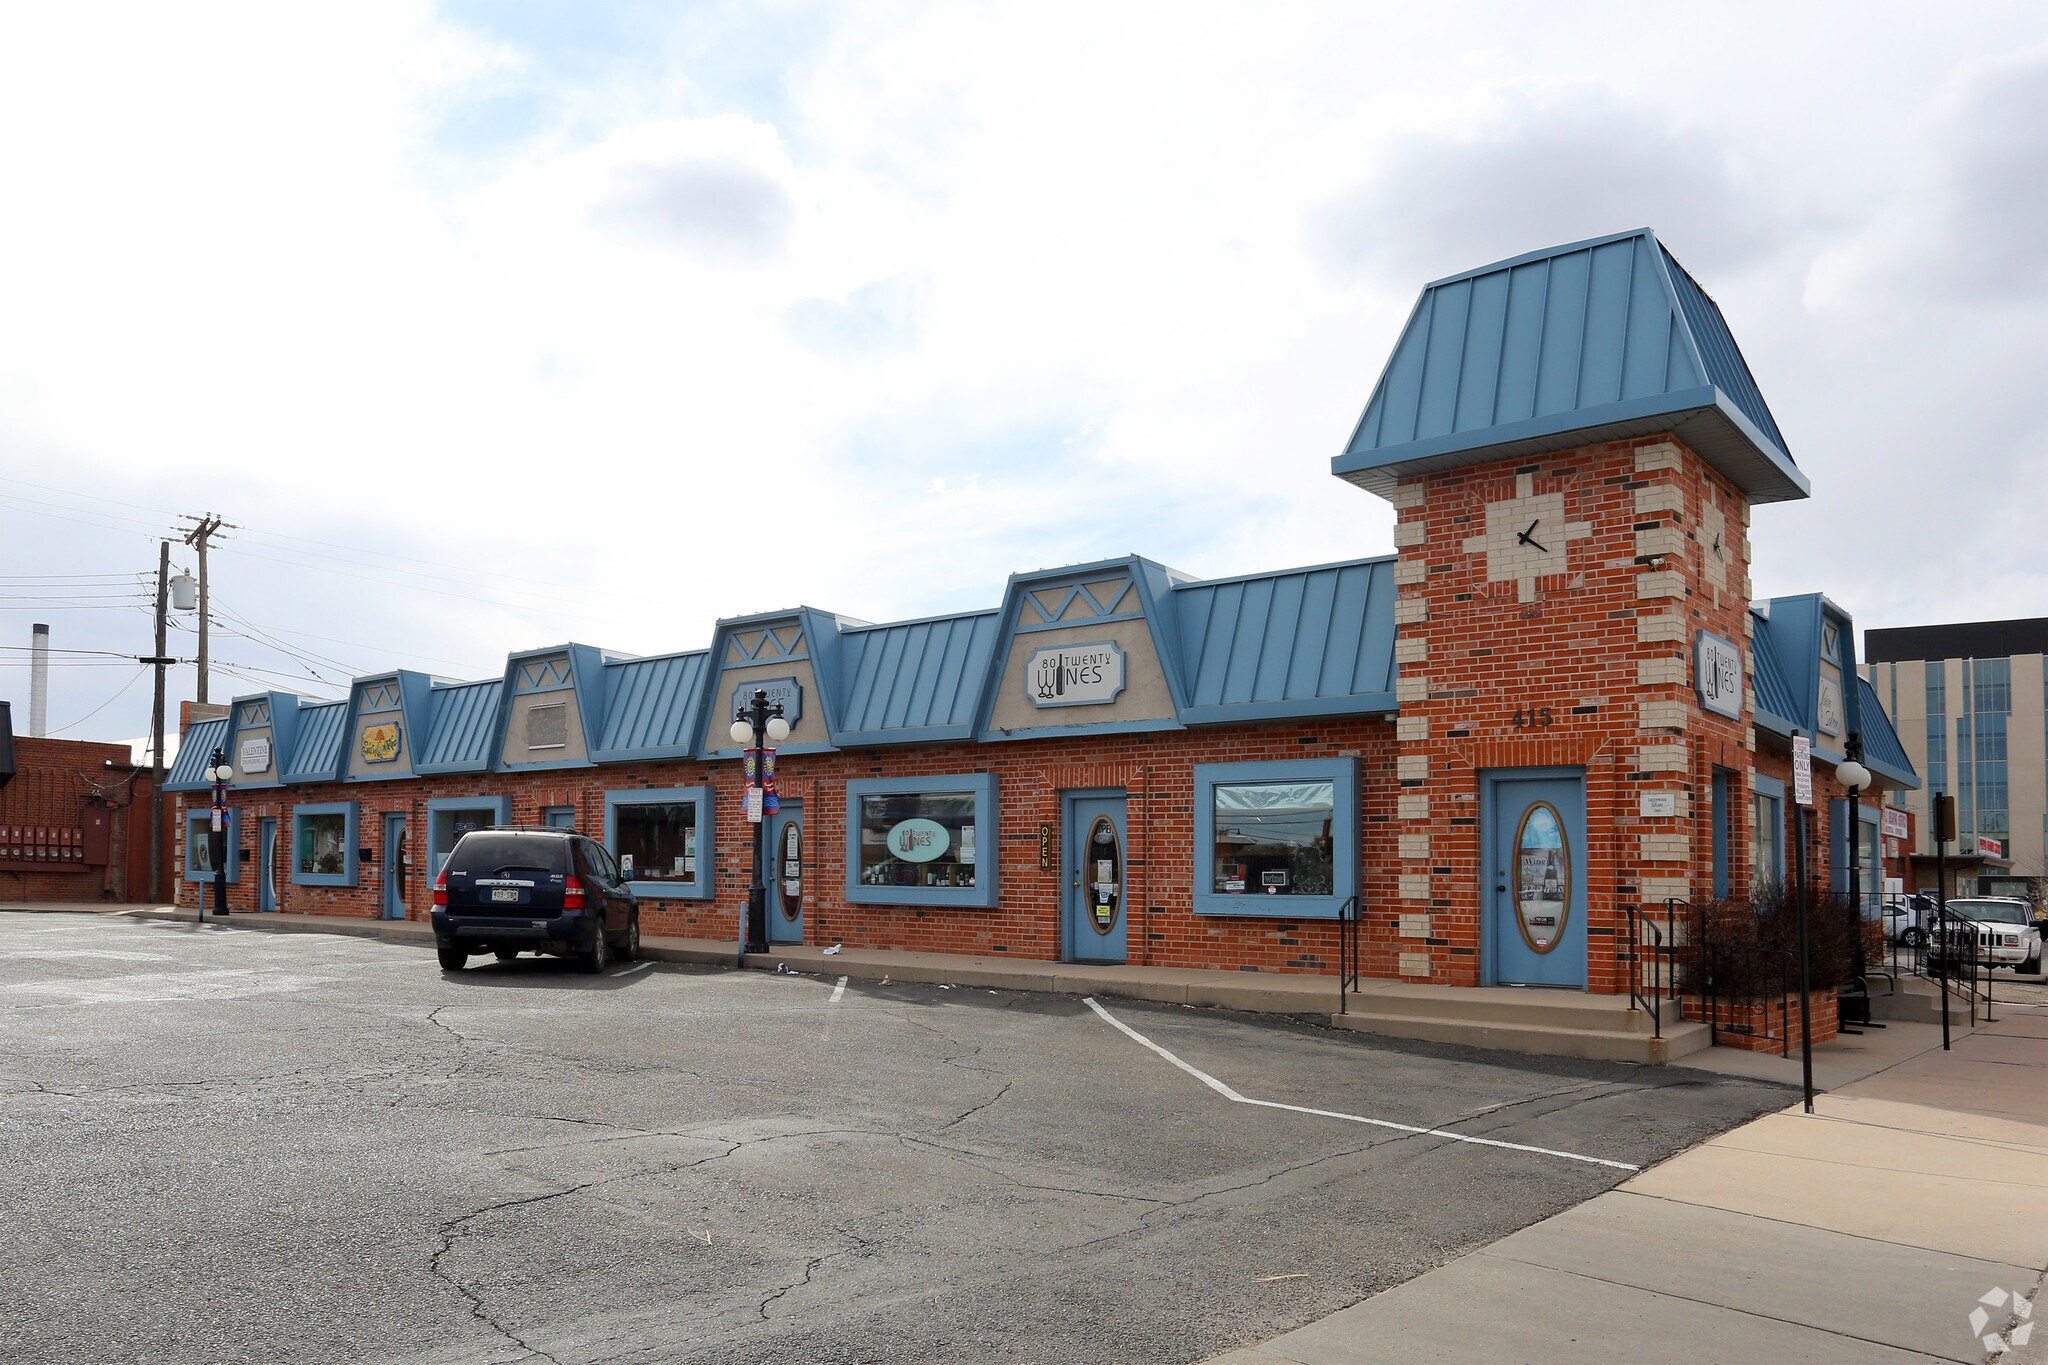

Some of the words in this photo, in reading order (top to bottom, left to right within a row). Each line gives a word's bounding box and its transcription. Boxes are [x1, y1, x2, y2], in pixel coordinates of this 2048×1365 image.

[1042, 658, 1056, 669] 80
[1065, 653, 1111, 666] TWENTY
[1707, 647, 1714, 662] 80
[1717, 652, 1737, 675] TWENTY
[1037, 665, 1102, 699] WINES
[743, 692, 753, 700] 80
[1512, 708, 1552, 728] 415
[1795, 760, 1811, 771] ONLY
[1524, 857, 1547, 865] Wine
